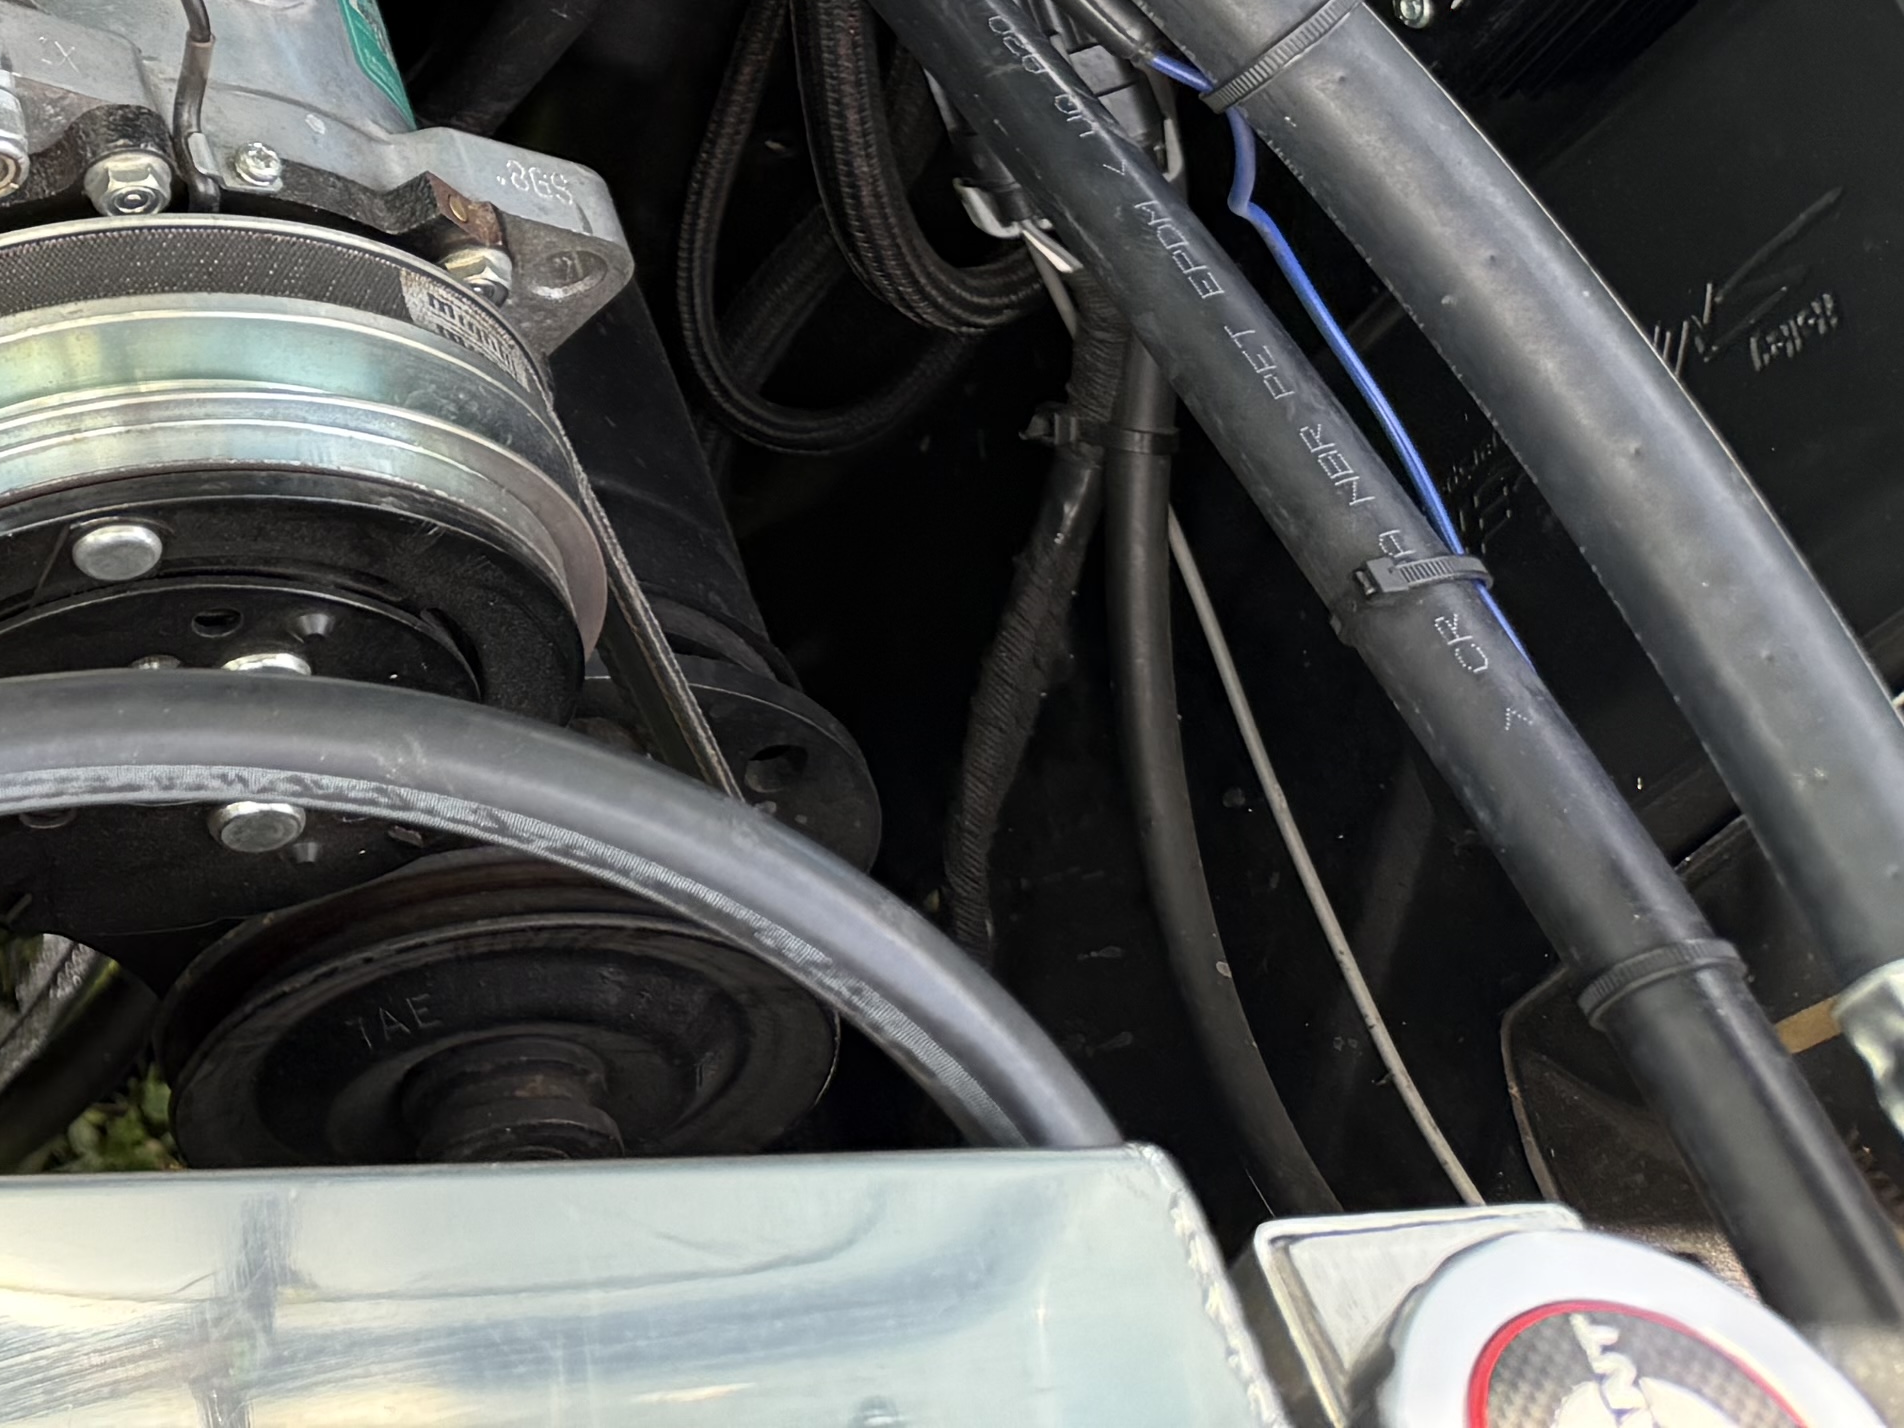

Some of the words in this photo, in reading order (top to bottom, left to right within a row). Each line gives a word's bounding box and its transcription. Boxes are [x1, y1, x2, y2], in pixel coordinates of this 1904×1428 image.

[1134, 199, 1226, 300] EPDM
[1224, 322, 1295, 401] PET
[1299, 422, 1377, 508] NBR
[1434, 611, 1490, 674] CR
